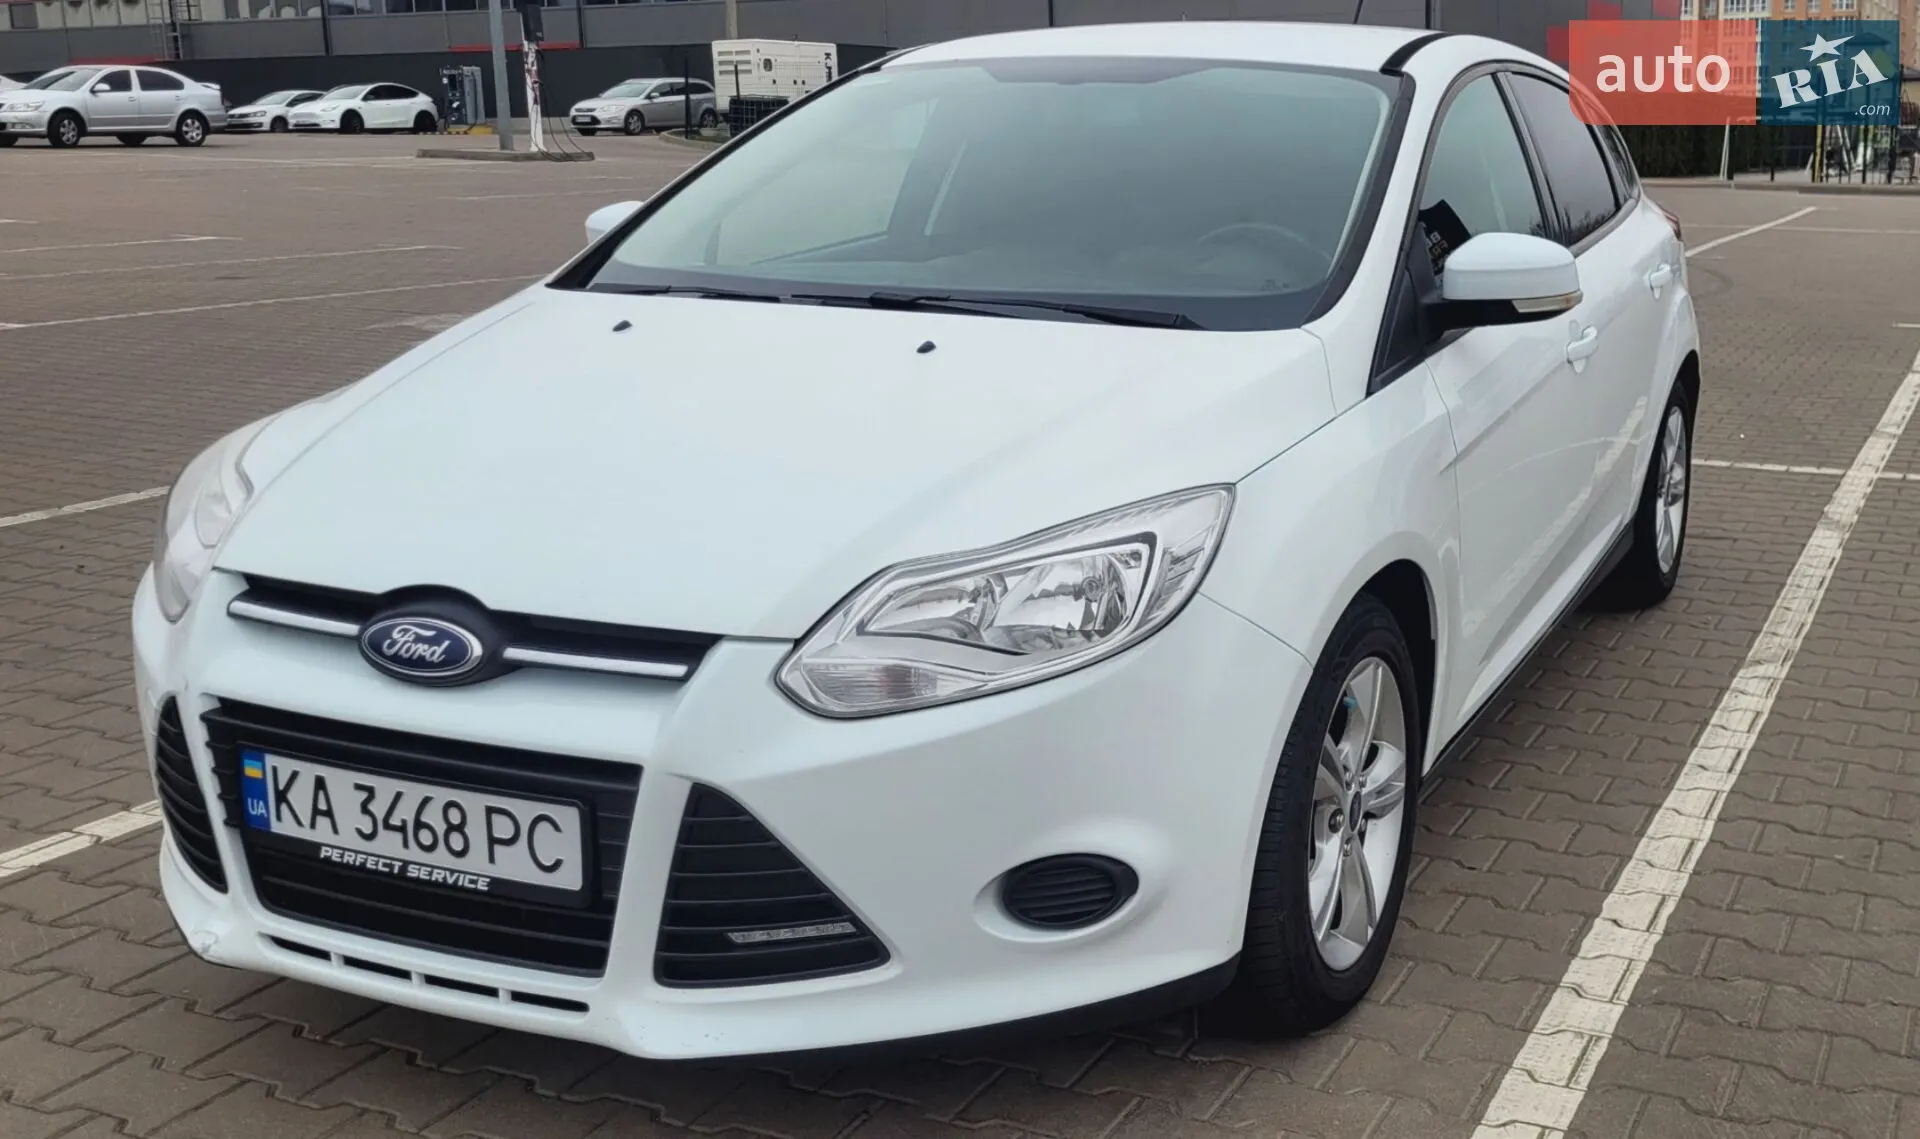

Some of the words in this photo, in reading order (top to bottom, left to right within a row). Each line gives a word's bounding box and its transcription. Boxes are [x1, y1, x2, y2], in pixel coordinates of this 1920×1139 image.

[382, 624, 452, 663] Ford
[247, 797, 267, 819] UA
[269, 764, 340, 836] KA
[353, 782, 470, 859] 3468
[484, 804, 564, 874] PC
[319, 845, 403, 875] PERFECT
[406, 863, 491, 891] SERVICE
